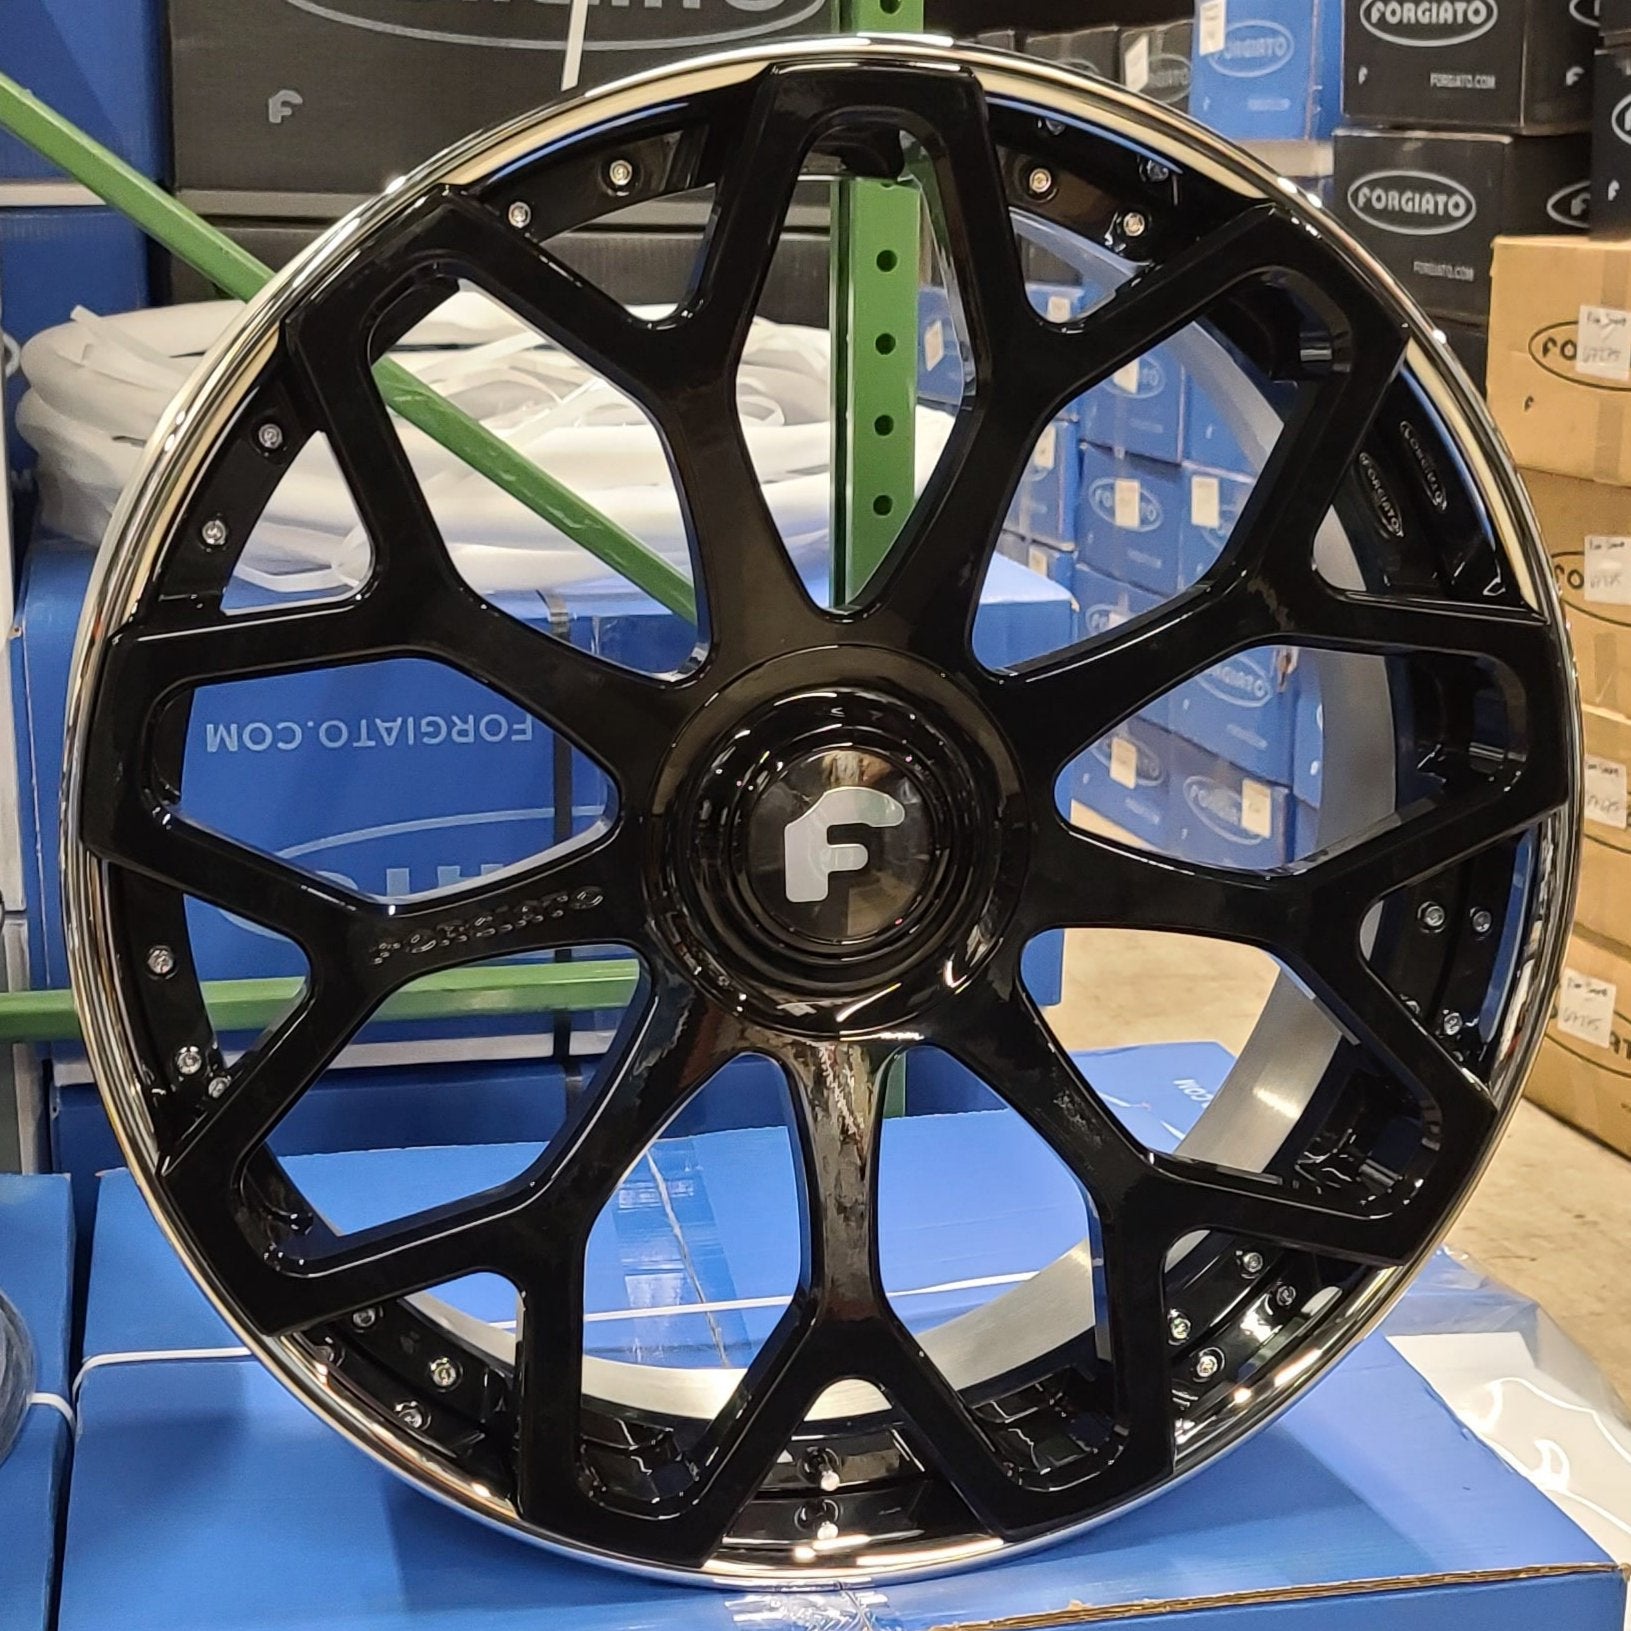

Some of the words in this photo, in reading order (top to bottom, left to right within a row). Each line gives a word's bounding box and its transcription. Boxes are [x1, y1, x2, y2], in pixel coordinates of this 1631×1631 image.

[1371, 0, 1488, 25] FORGIATO
[1358, 187, 1467, 218] FORGIATO
[205, 713, 533, 753] FORGIATO.COM
